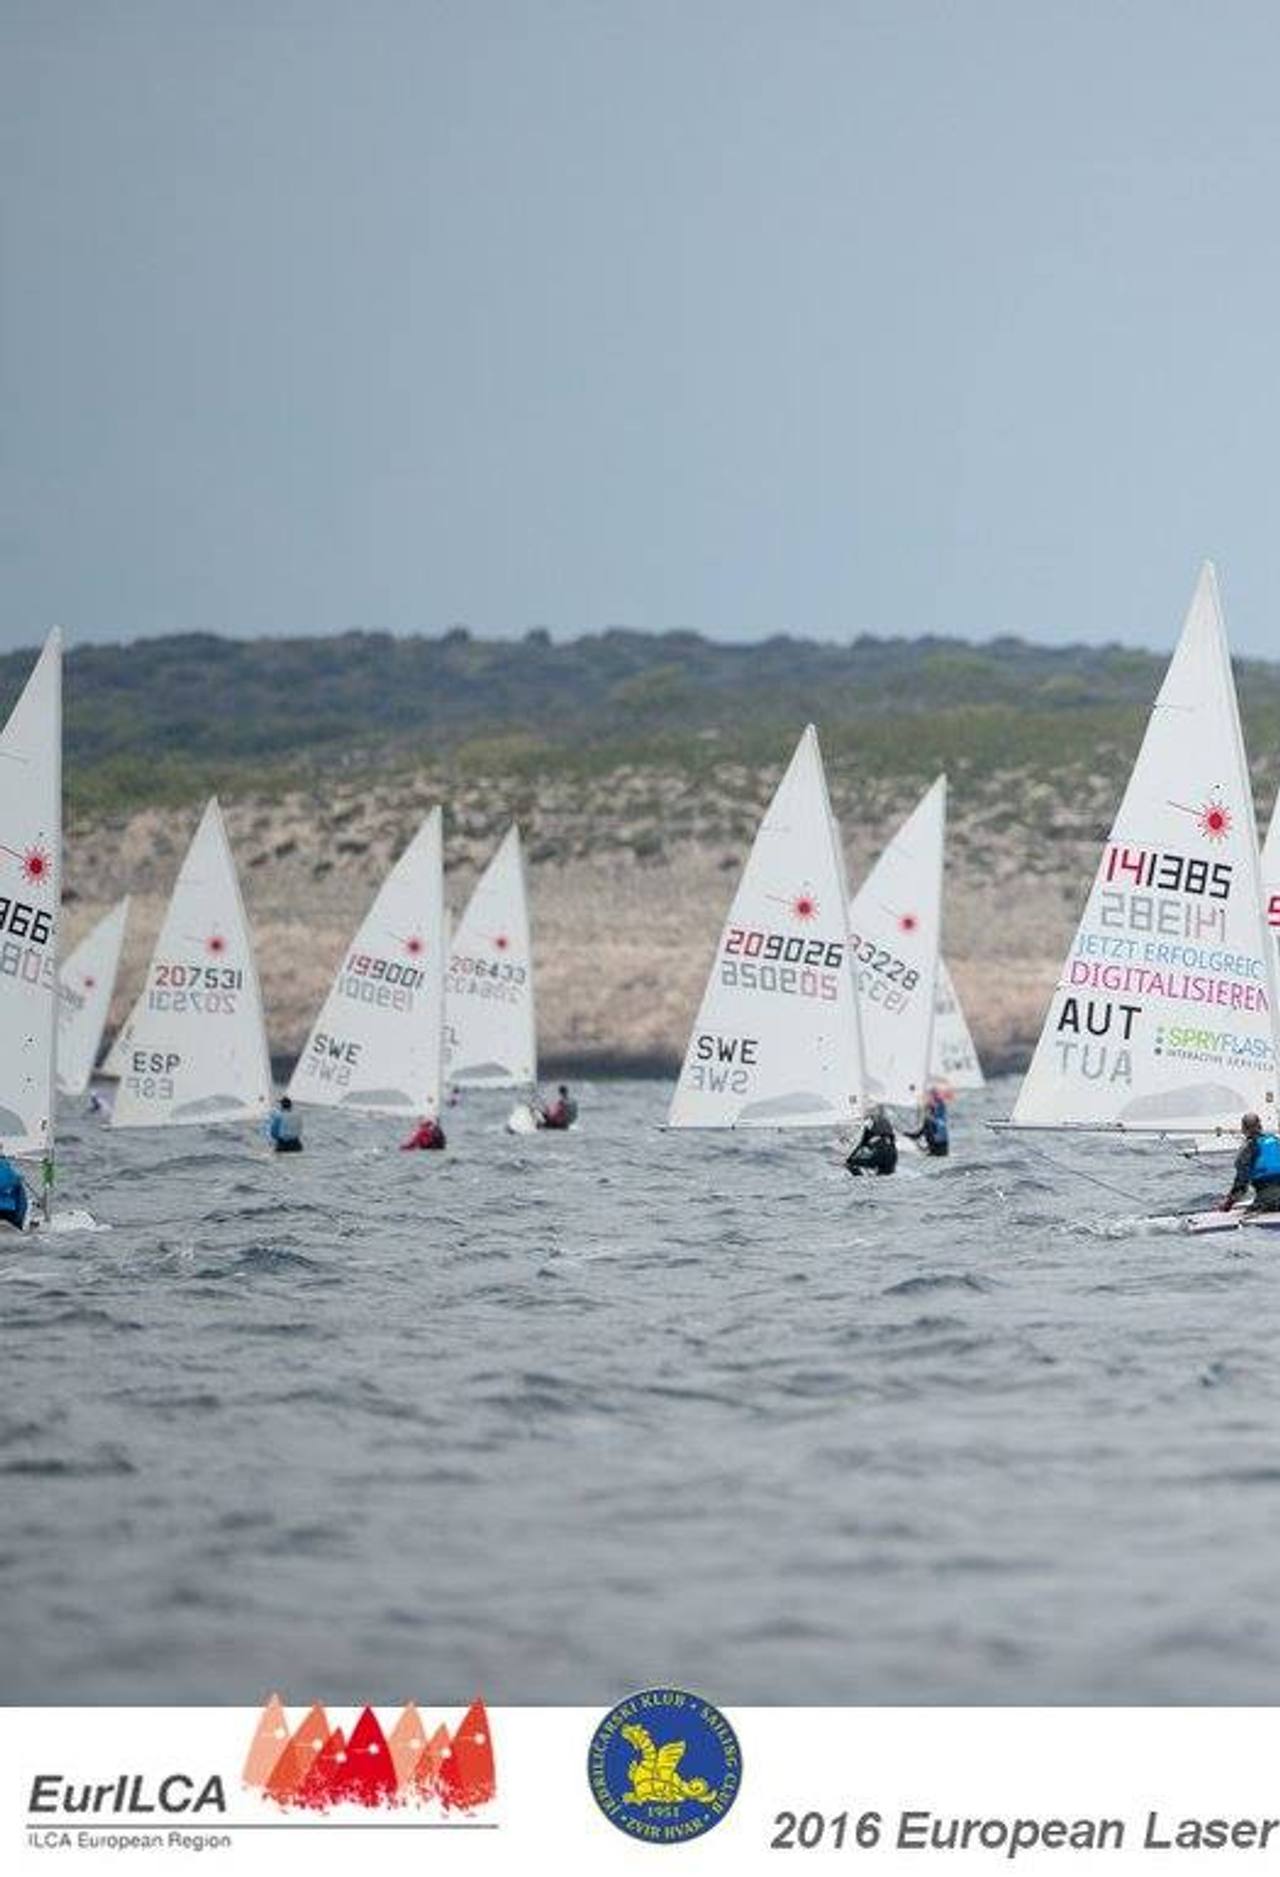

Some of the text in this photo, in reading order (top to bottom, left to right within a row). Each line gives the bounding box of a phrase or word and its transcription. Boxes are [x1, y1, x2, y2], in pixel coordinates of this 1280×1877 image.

[1106, 847, 1233, 900] 141385
[725, 929, 844, 968] 209026
[1075, 934, 1138, 959] JETZT
[155, 965, 242, 990] 207531
[347, 954, 425, 989] 199001
[1070, 959, 1270, 1011] DIGITALISIEREN
[1057, 997, 1142, 1040] AUT
[133, 1051, 181, 1074] ESP
[312, 1033, 362, 1065] SWE
[697, 1035, 758, 1065] SWE
